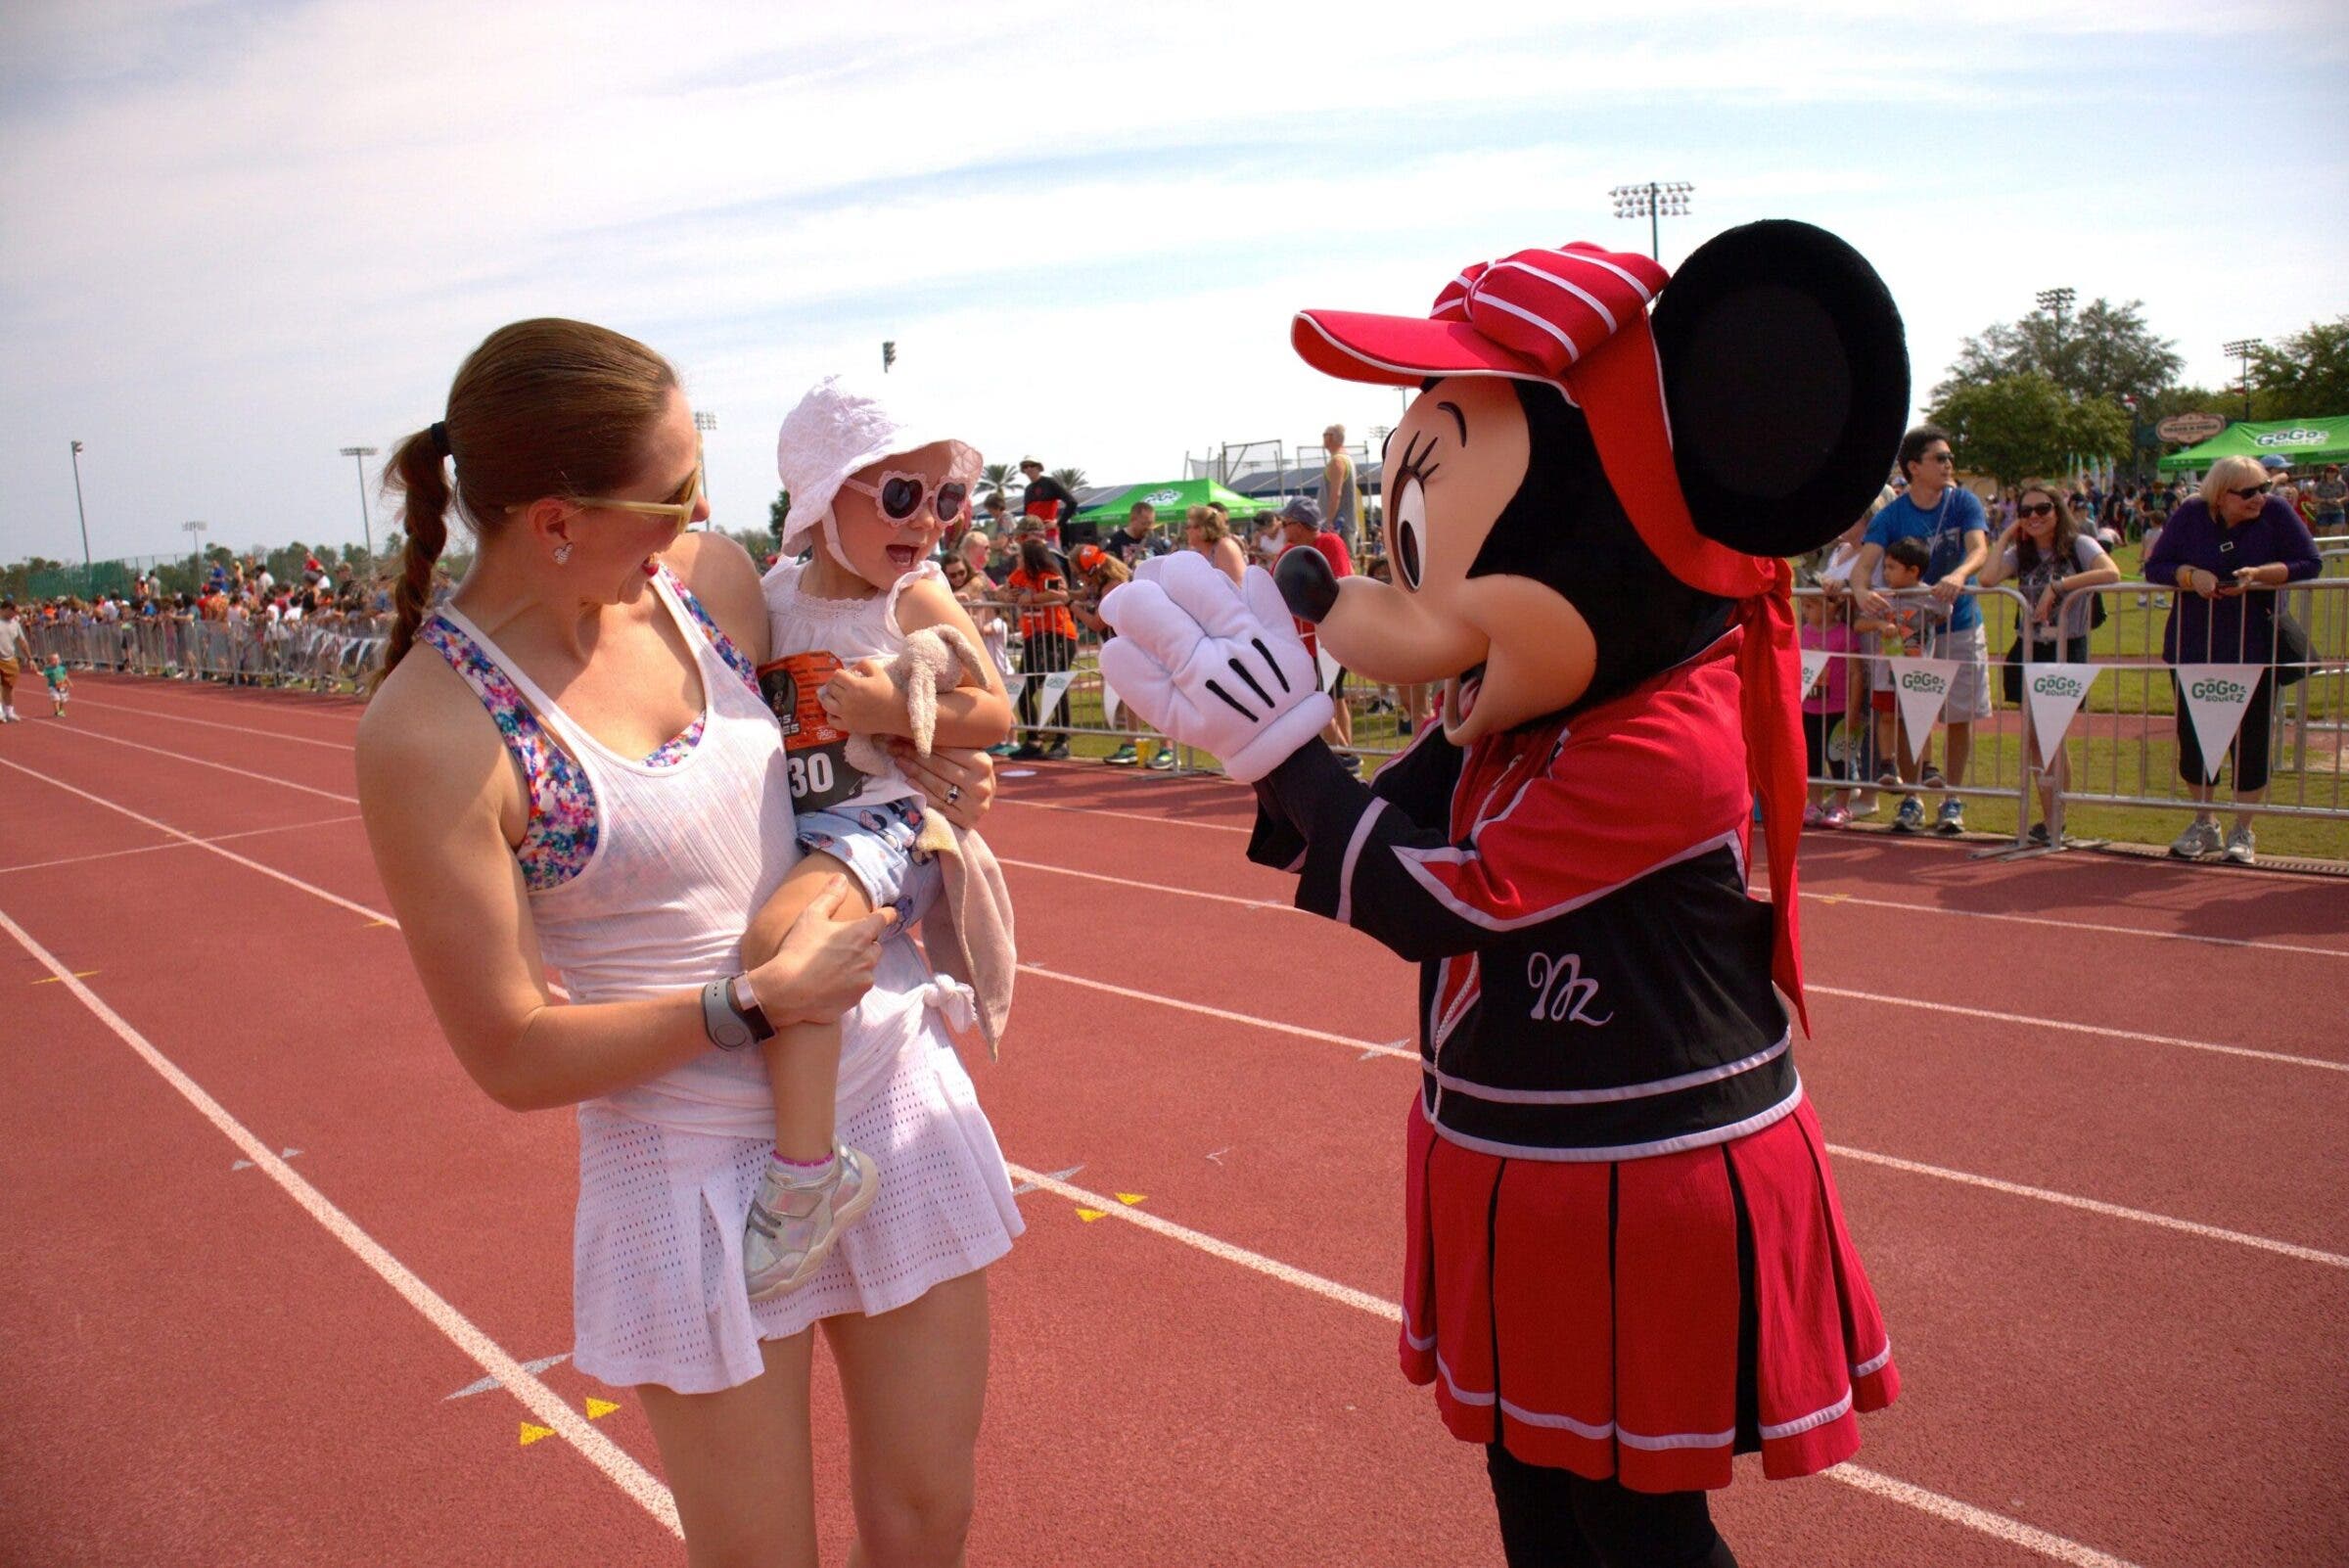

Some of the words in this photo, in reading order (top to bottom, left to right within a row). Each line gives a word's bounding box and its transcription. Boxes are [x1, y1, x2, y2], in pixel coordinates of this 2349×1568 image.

[1902, 673, 1940, 689] GoGo
[2034, 676, 2076, 693] GoGo
[2191, 680, 2239, 699] GoGo
[787, 753, 834, 798] 30
